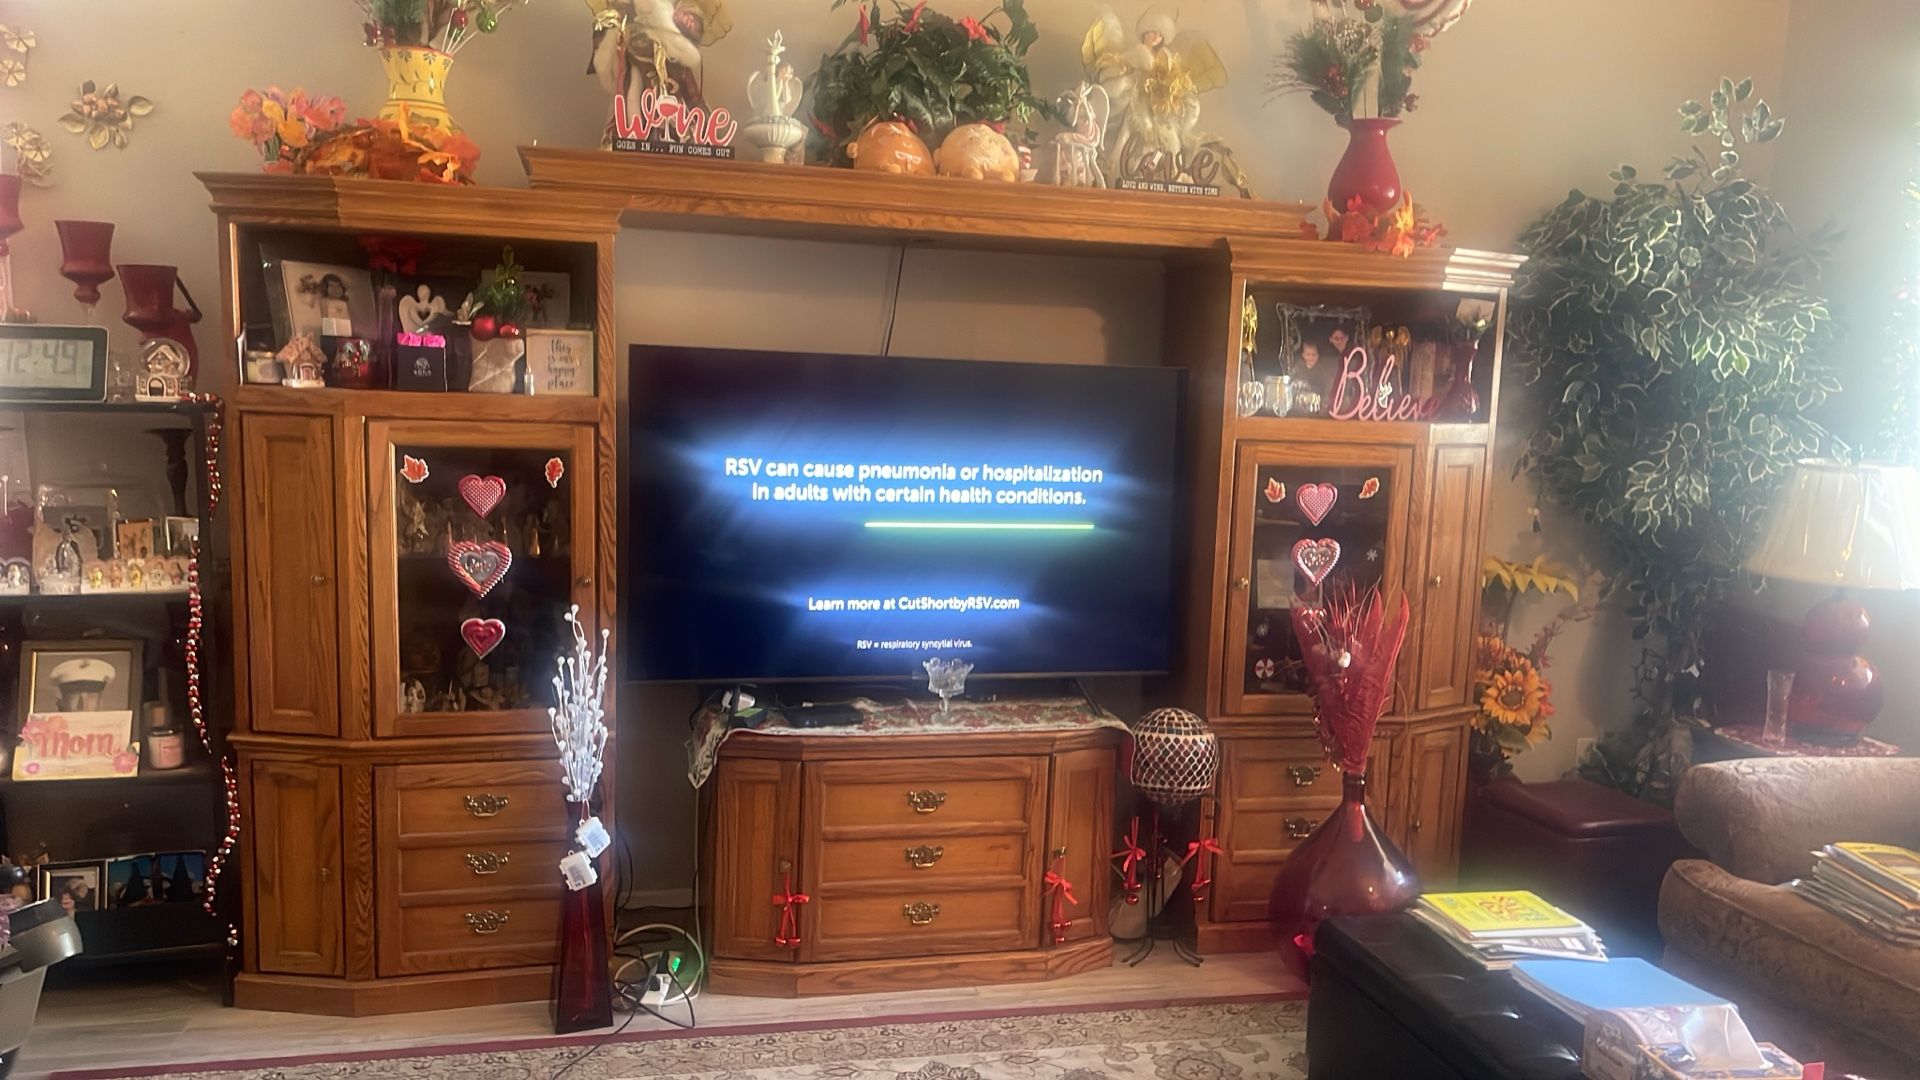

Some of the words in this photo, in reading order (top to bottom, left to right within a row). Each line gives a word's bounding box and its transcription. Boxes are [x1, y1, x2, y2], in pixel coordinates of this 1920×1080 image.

[616, 140, 636, 150] GOES
[668, 145, 684, 154] FUN
[687, 147, 712, 156] COMES
[715, 149, 731, 158] OUT
[725, 457, 762, 477] RSV
[765, 461, 799, 478] can
[802, 462, 855, 479] cause
[858, 463, 957, 483] pneumonia
[960, 466, 979, 481] or
[982, 464, 1103, 485] hospitalization
[773, 483, 829, 502] adults
[832, 484, 872, 502] with
[874, 484, 936, 504] certain
[939, 486, 992, 504] health
[995, 488, 1087, 505] conditions.
[808, 597, 845, 611] Learn
[847, 599, 881, 611] more
[883, 598, 896, 610] at
[898, 597, 1020, 613] CutShortbyRSV.com
[856, 639, 873, 650] RSV
[880, 639, 920, 650] respiratory
[921, 639, 953, 650] syncytial
[954, 638, 973, 649] virus.
